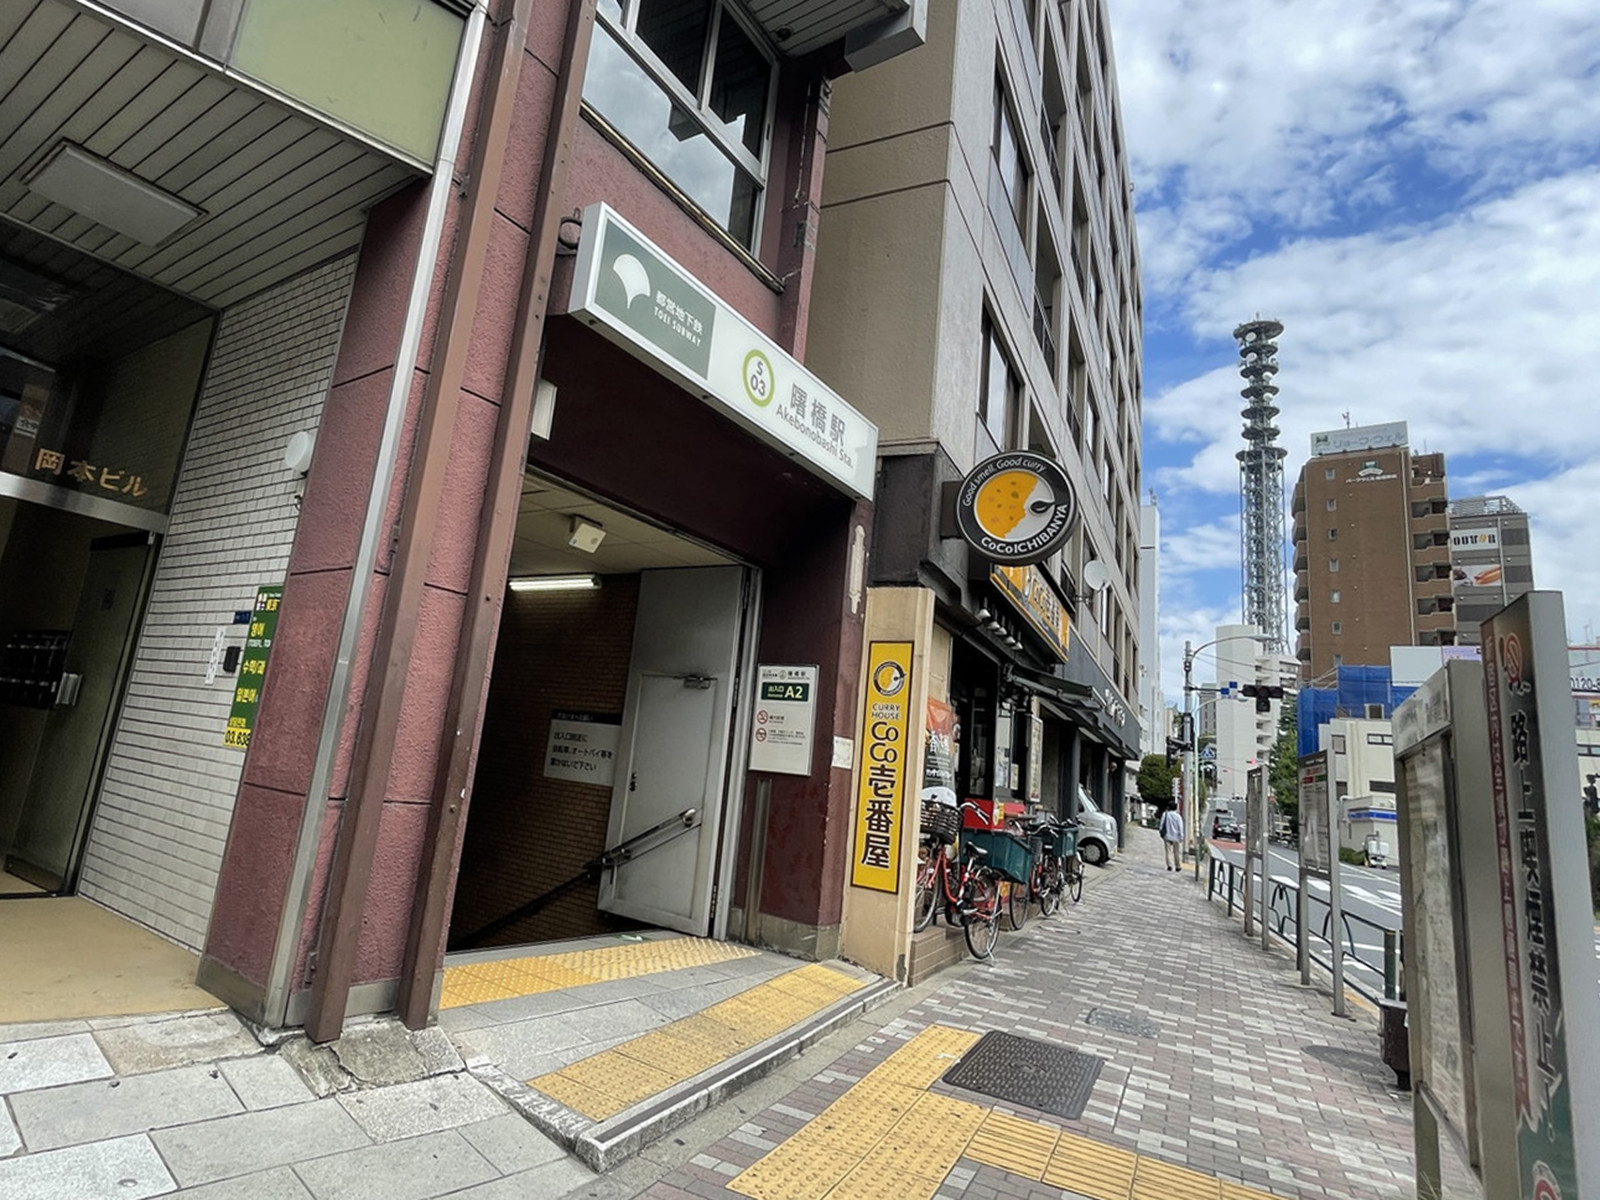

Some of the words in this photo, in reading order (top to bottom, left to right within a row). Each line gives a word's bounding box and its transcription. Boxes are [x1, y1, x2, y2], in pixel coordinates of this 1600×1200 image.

[655, 290, 703, 336] 都営地下鉄
[750, 374, 766, 397] 03
[756, 361, 764, 376] S
[776, 403, 838, 457] Akebonobashi
[838, 449, 854, 468] Sta.
[790, 382, 846, 447] 曙橋駅
[34, 448, 148, 497] 岡本ビル
[962, 481, 977, 507] Good
[996, 456, 1023, 470] Good
[1022, 459, 1047, 473] curry
[981, 503, 1068, 554] CoCoICHIBANYA
[784, 685, 803, 699] A2
[872, 703, 901, 712] CURRY
[871, 711, 901, 720] HOUSE
